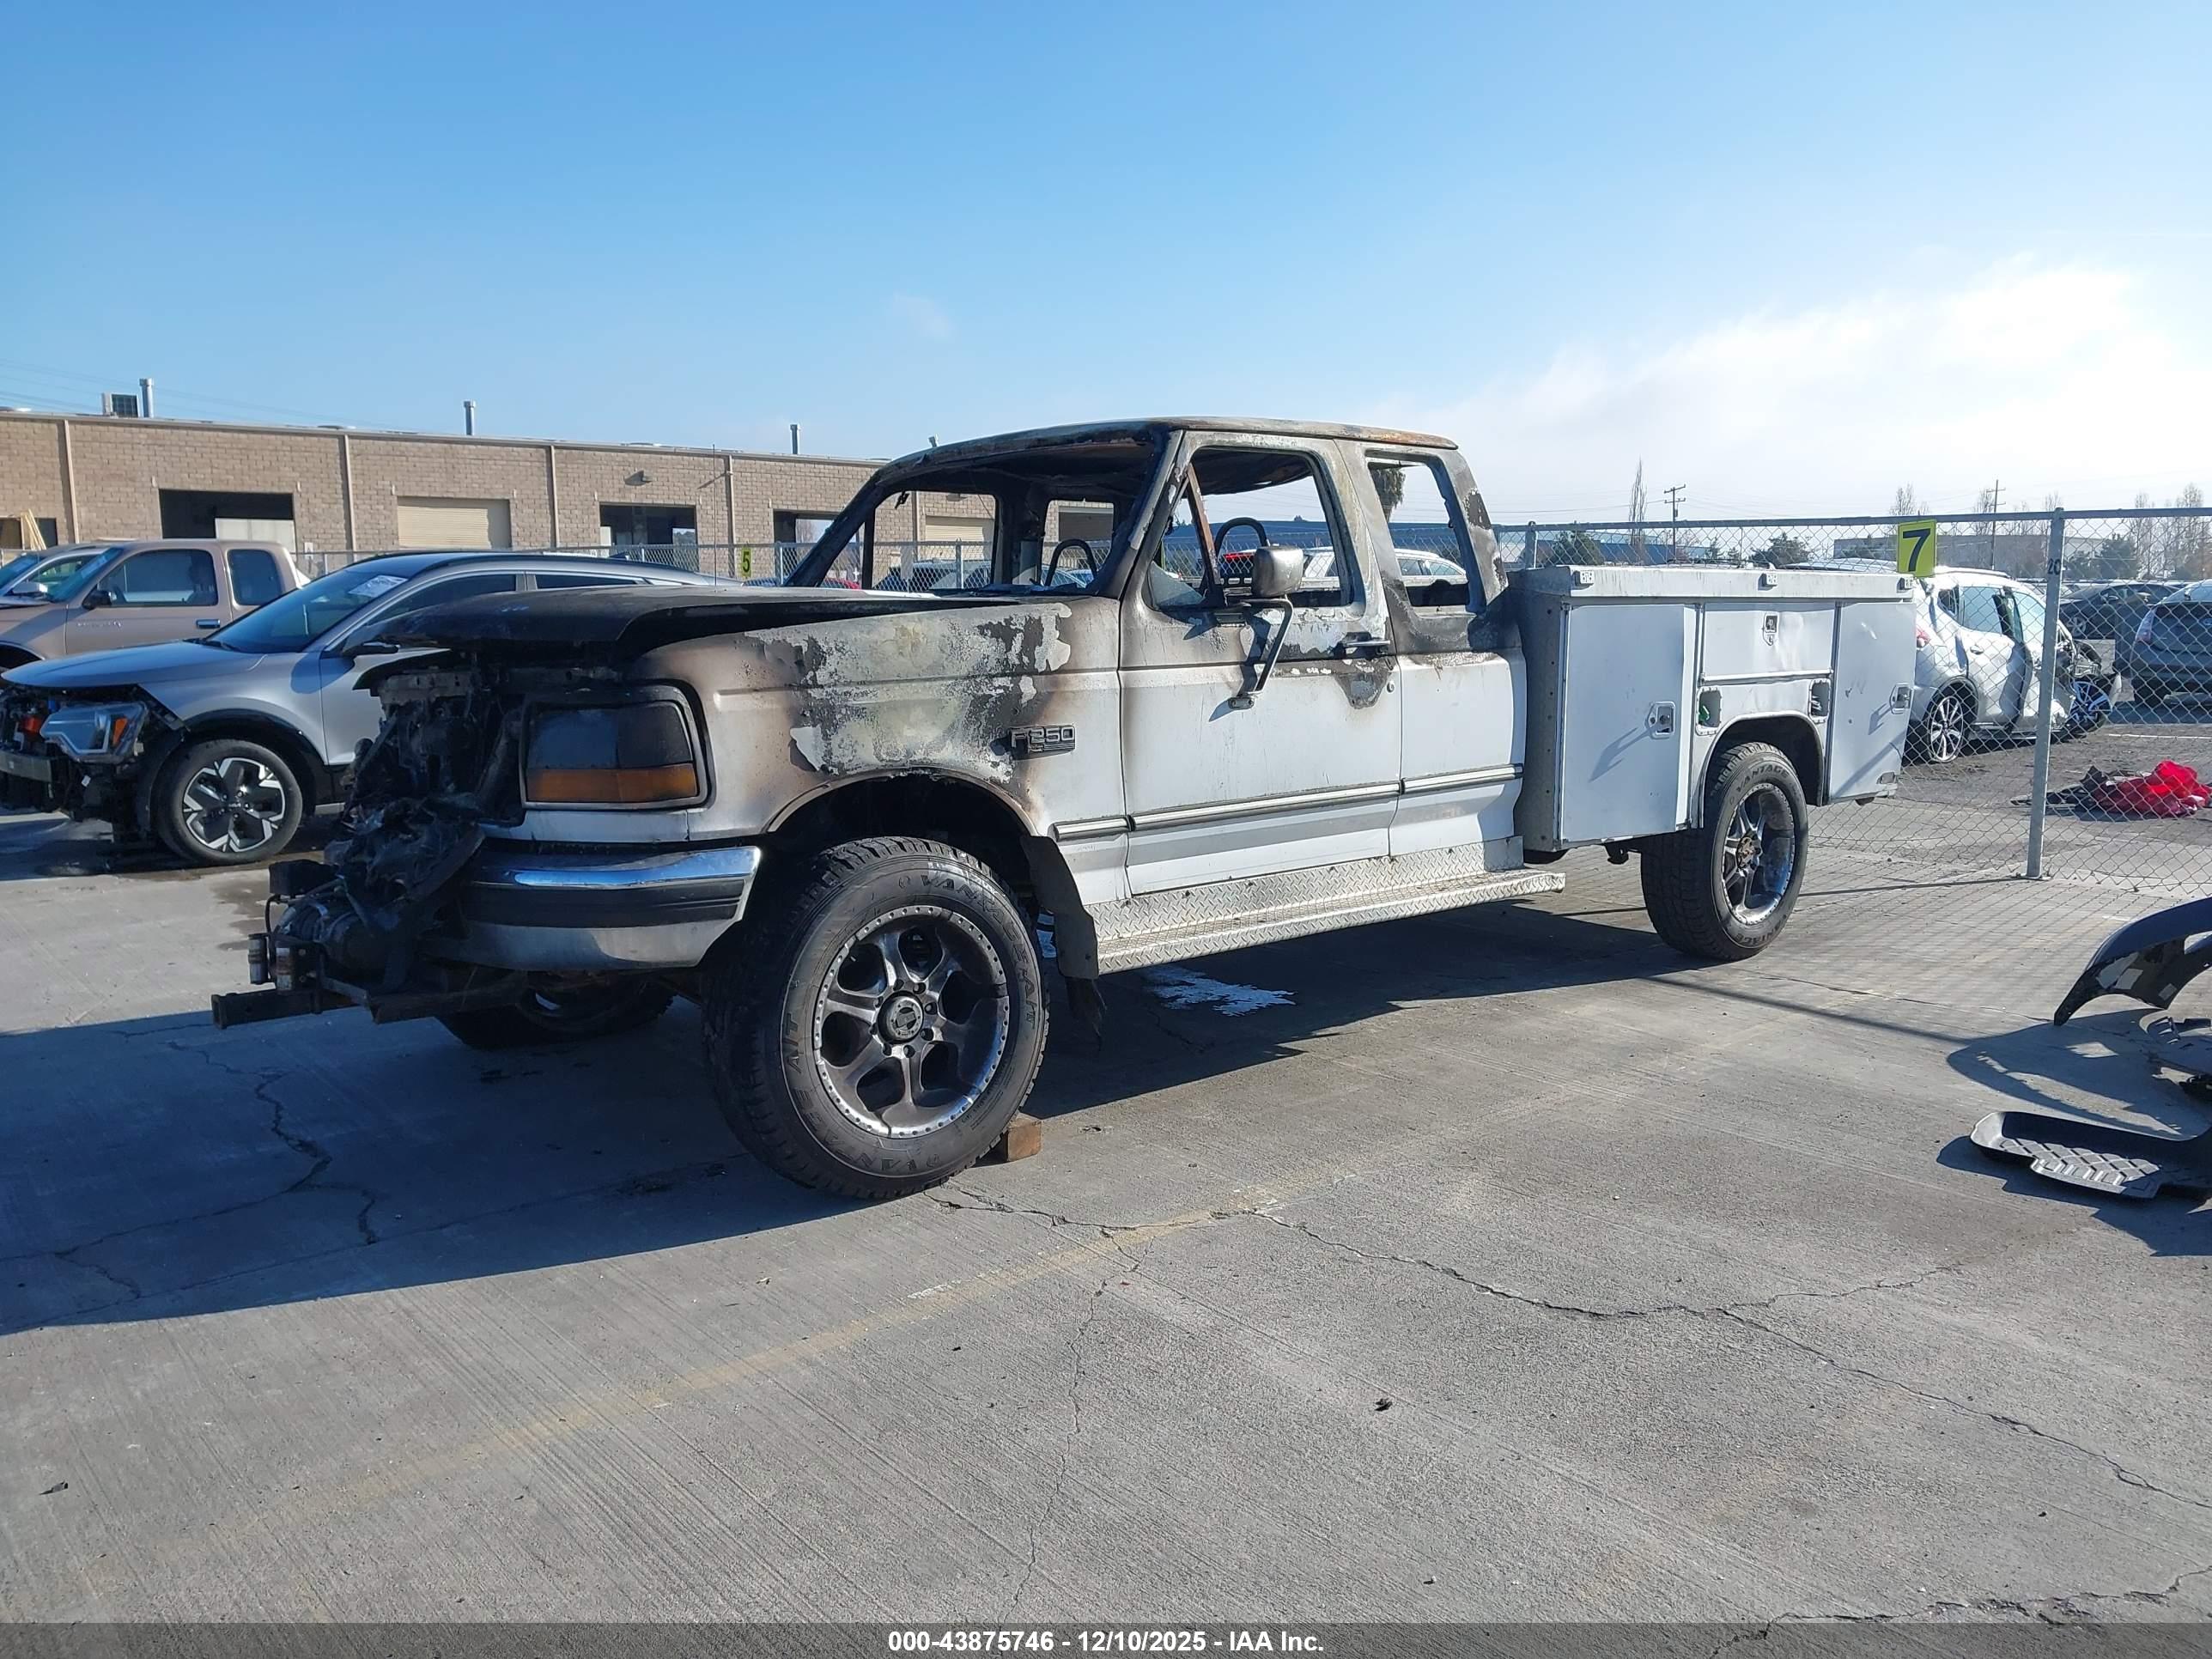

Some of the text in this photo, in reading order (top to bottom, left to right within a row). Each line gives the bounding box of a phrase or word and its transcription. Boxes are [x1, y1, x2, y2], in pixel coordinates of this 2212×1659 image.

[743, 550, 750, 573] 5
[1902, 528, 1931, 572] 7
[2047, 558, 2061, 575] 20
